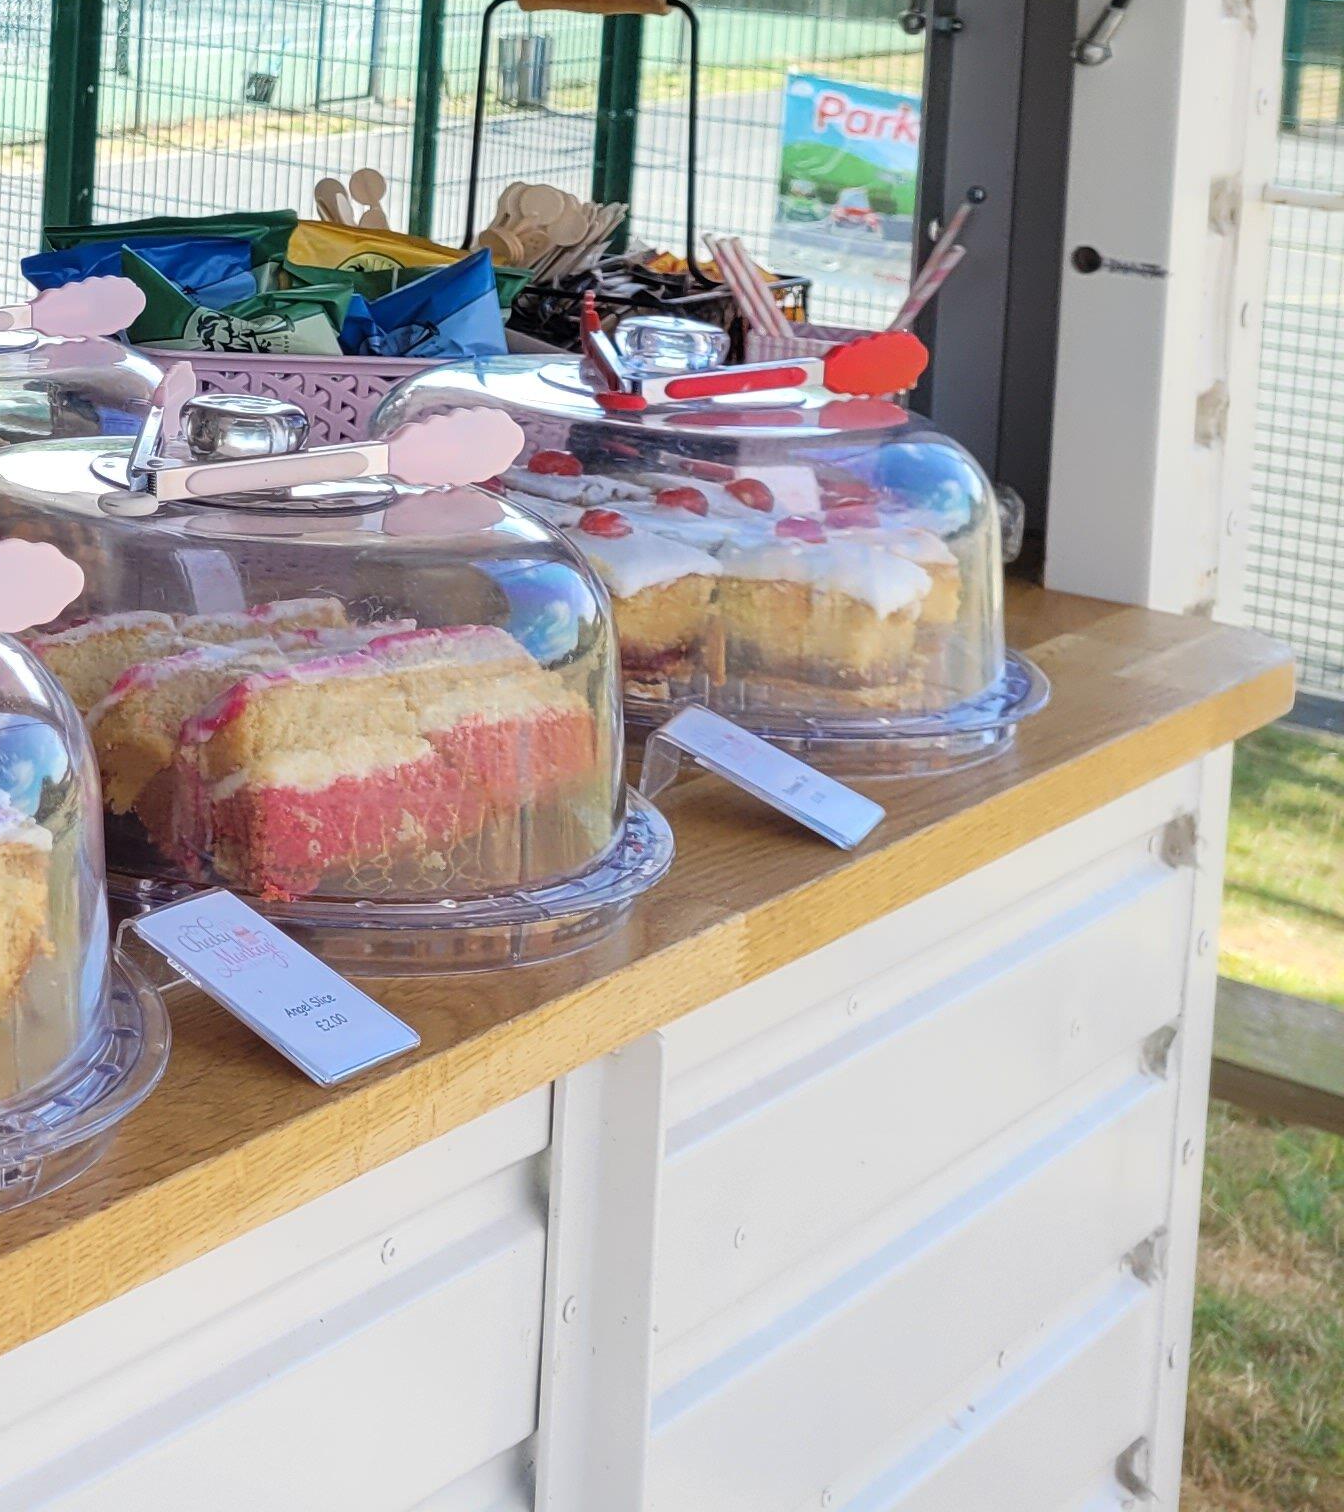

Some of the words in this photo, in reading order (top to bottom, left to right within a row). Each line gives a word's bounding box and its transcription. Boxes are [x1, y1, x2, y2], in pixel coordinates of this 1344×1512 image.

[284, 1001, 312, 1018] Angel
[309, 993, 337, 1009] Slice
[316, 1013, 348, 1032] £2.00
